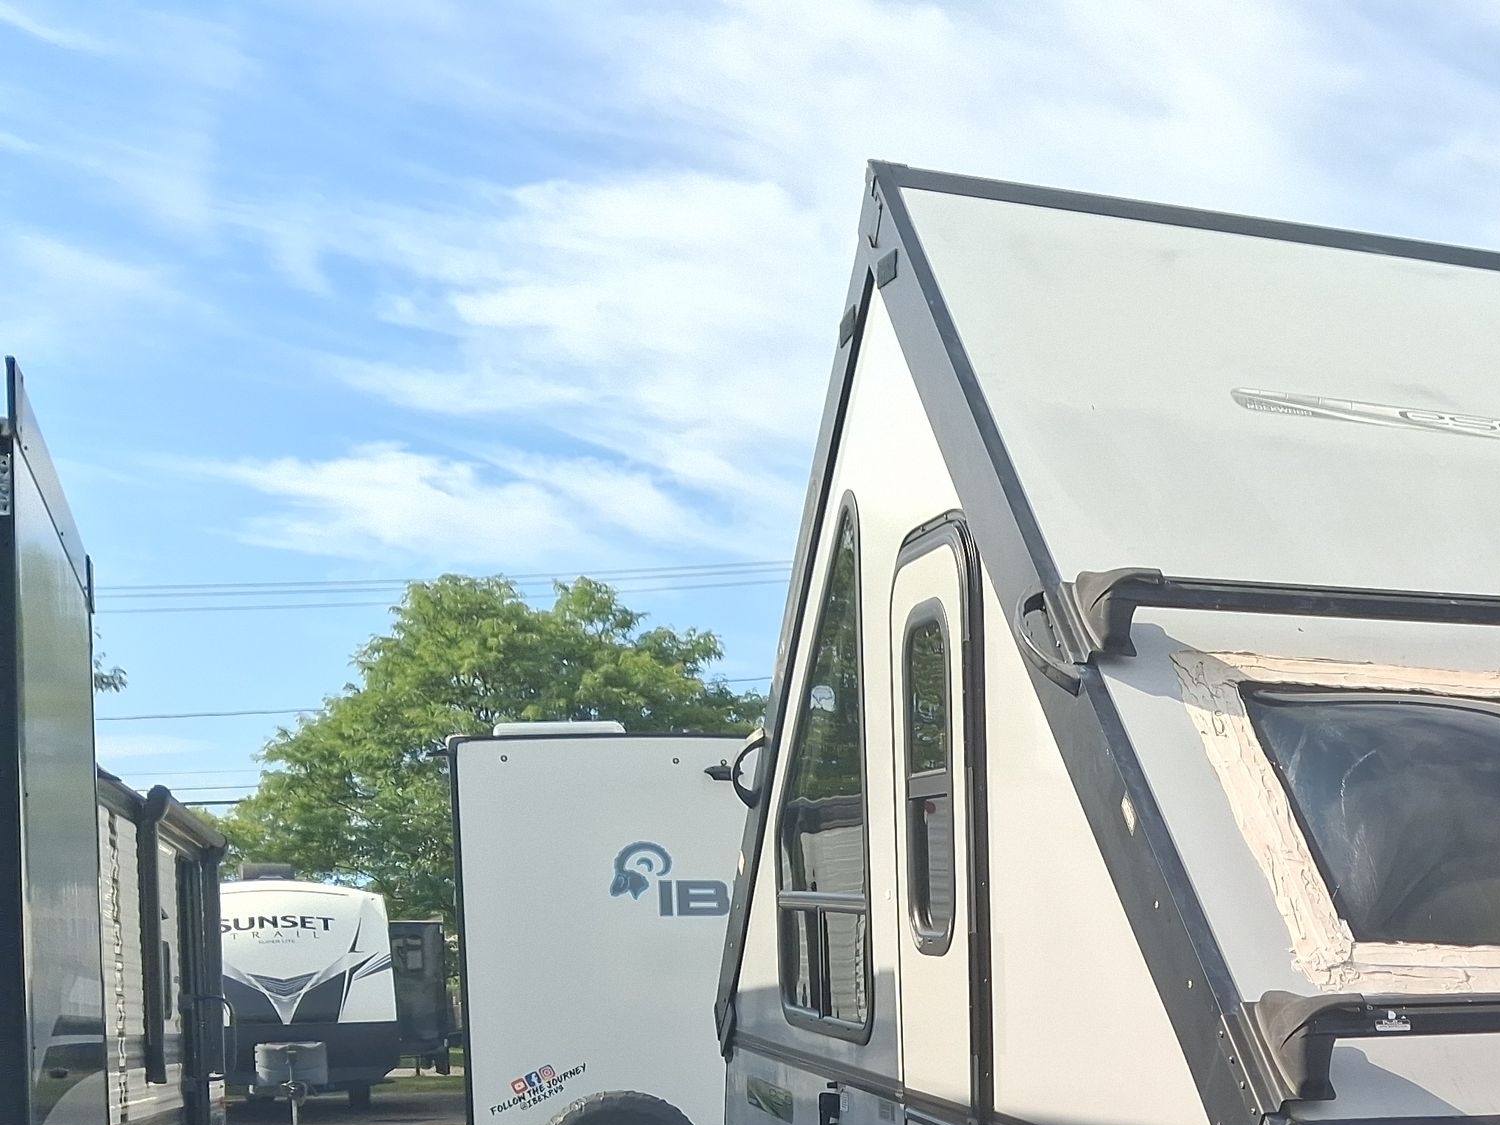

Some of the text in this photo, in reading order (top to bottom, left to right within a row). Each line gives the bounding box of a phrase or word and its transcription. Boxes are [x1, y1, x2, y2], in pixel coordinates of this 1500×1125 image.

[657, 879, 731, 917] IB
[220, 915, 335, 934] SUNSET
[231, 930, 320, 941] TRAIL
[490, 1062, 587, 1116] FOLLOW THE JOURNEY
